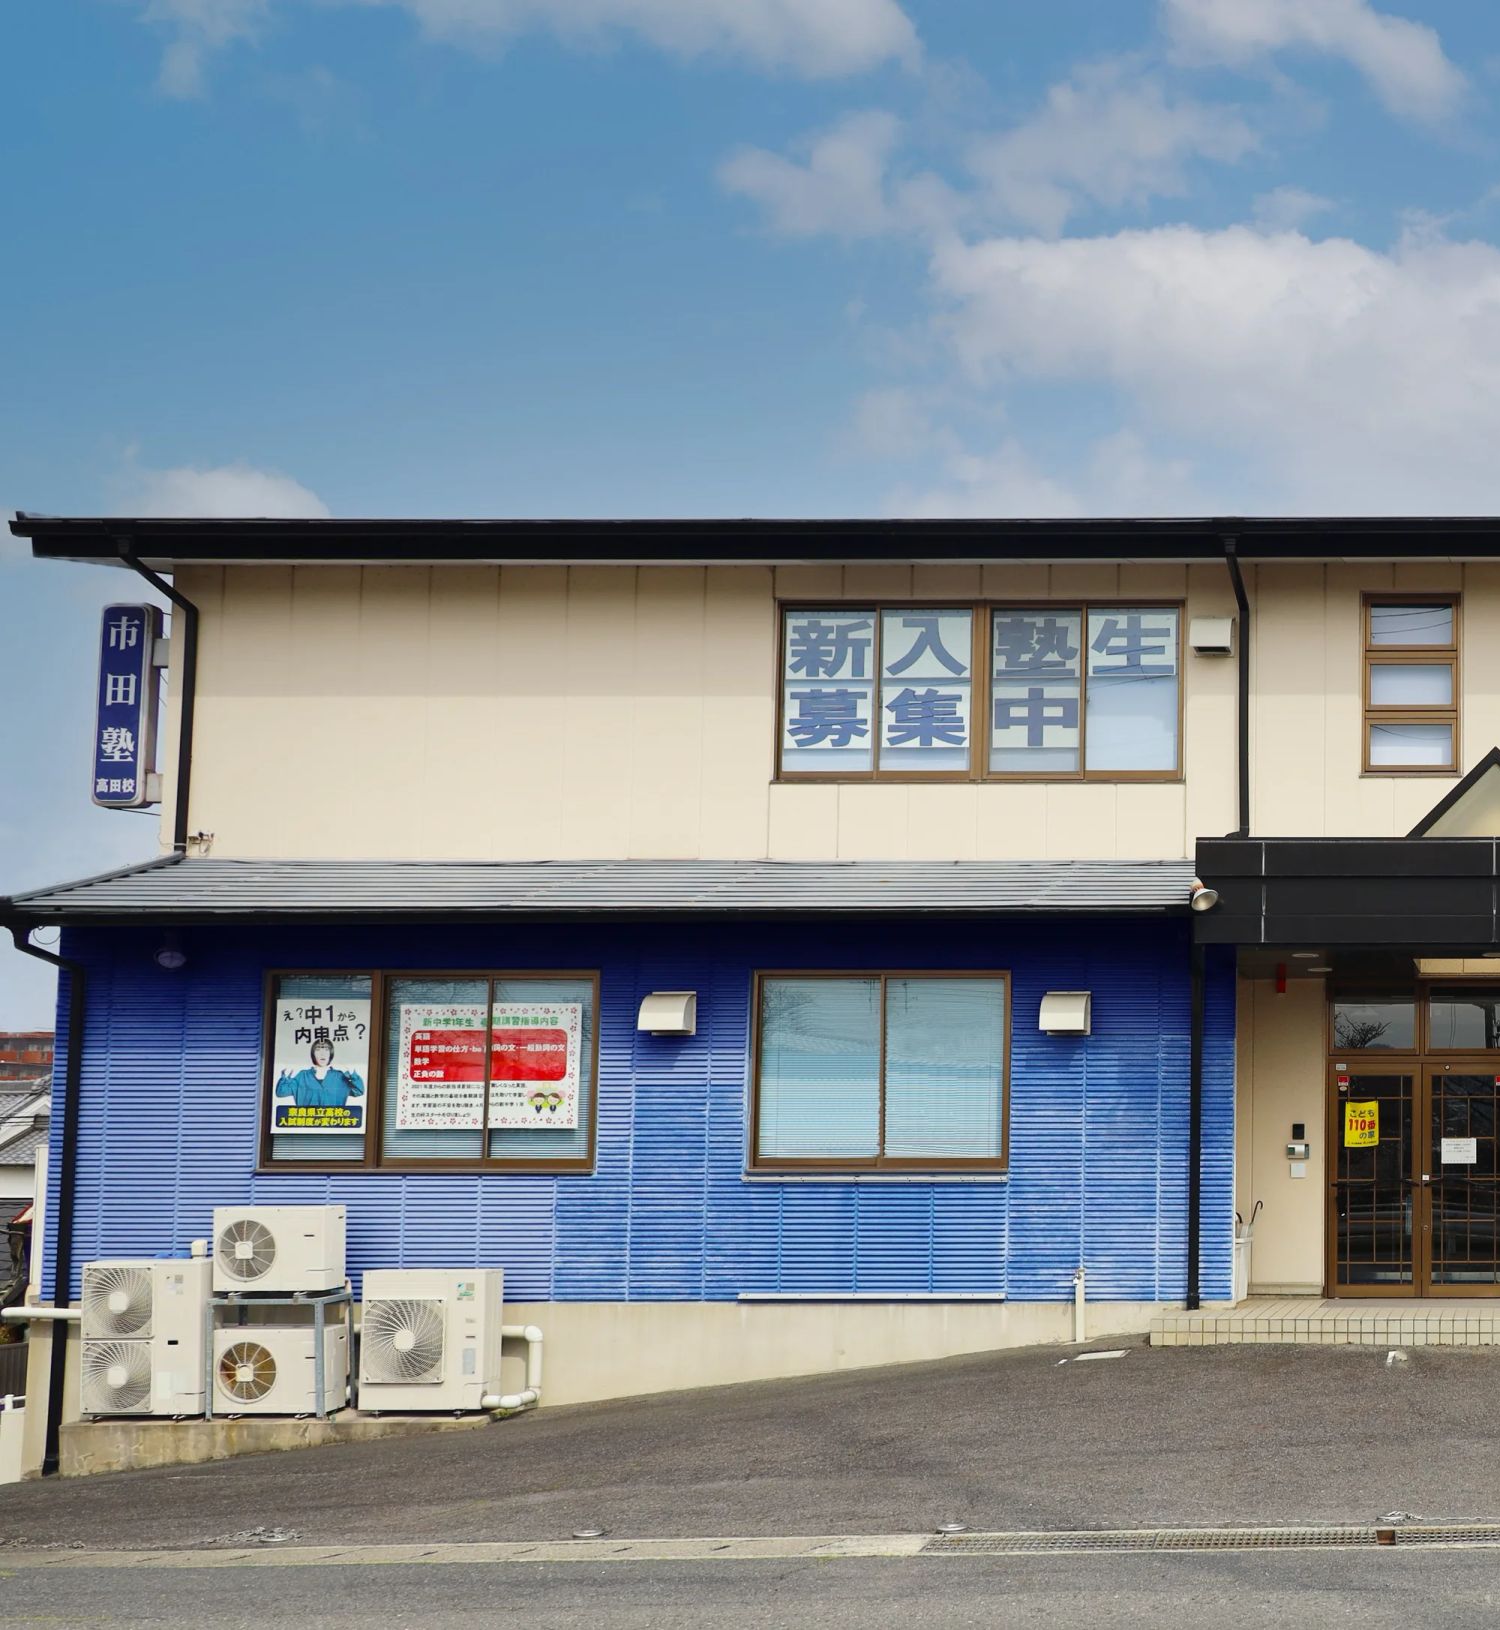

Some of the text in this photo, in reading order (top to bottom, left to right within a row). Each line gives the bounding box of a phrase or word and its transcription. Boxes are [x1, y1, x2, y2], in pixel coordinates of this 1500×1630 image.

[789, 616, 1174, 678] 新入塾生
[100, 616, 140, 762] 市田塾
[786, 687, 1079, 748] 募集中
[96, 778, 135, 793] 高田校
[1350, 1109, 1375, 1118] こども
[1349, 1119, 1376, 1131] 110番
[1359, 1130, 1376, 1139] の家
